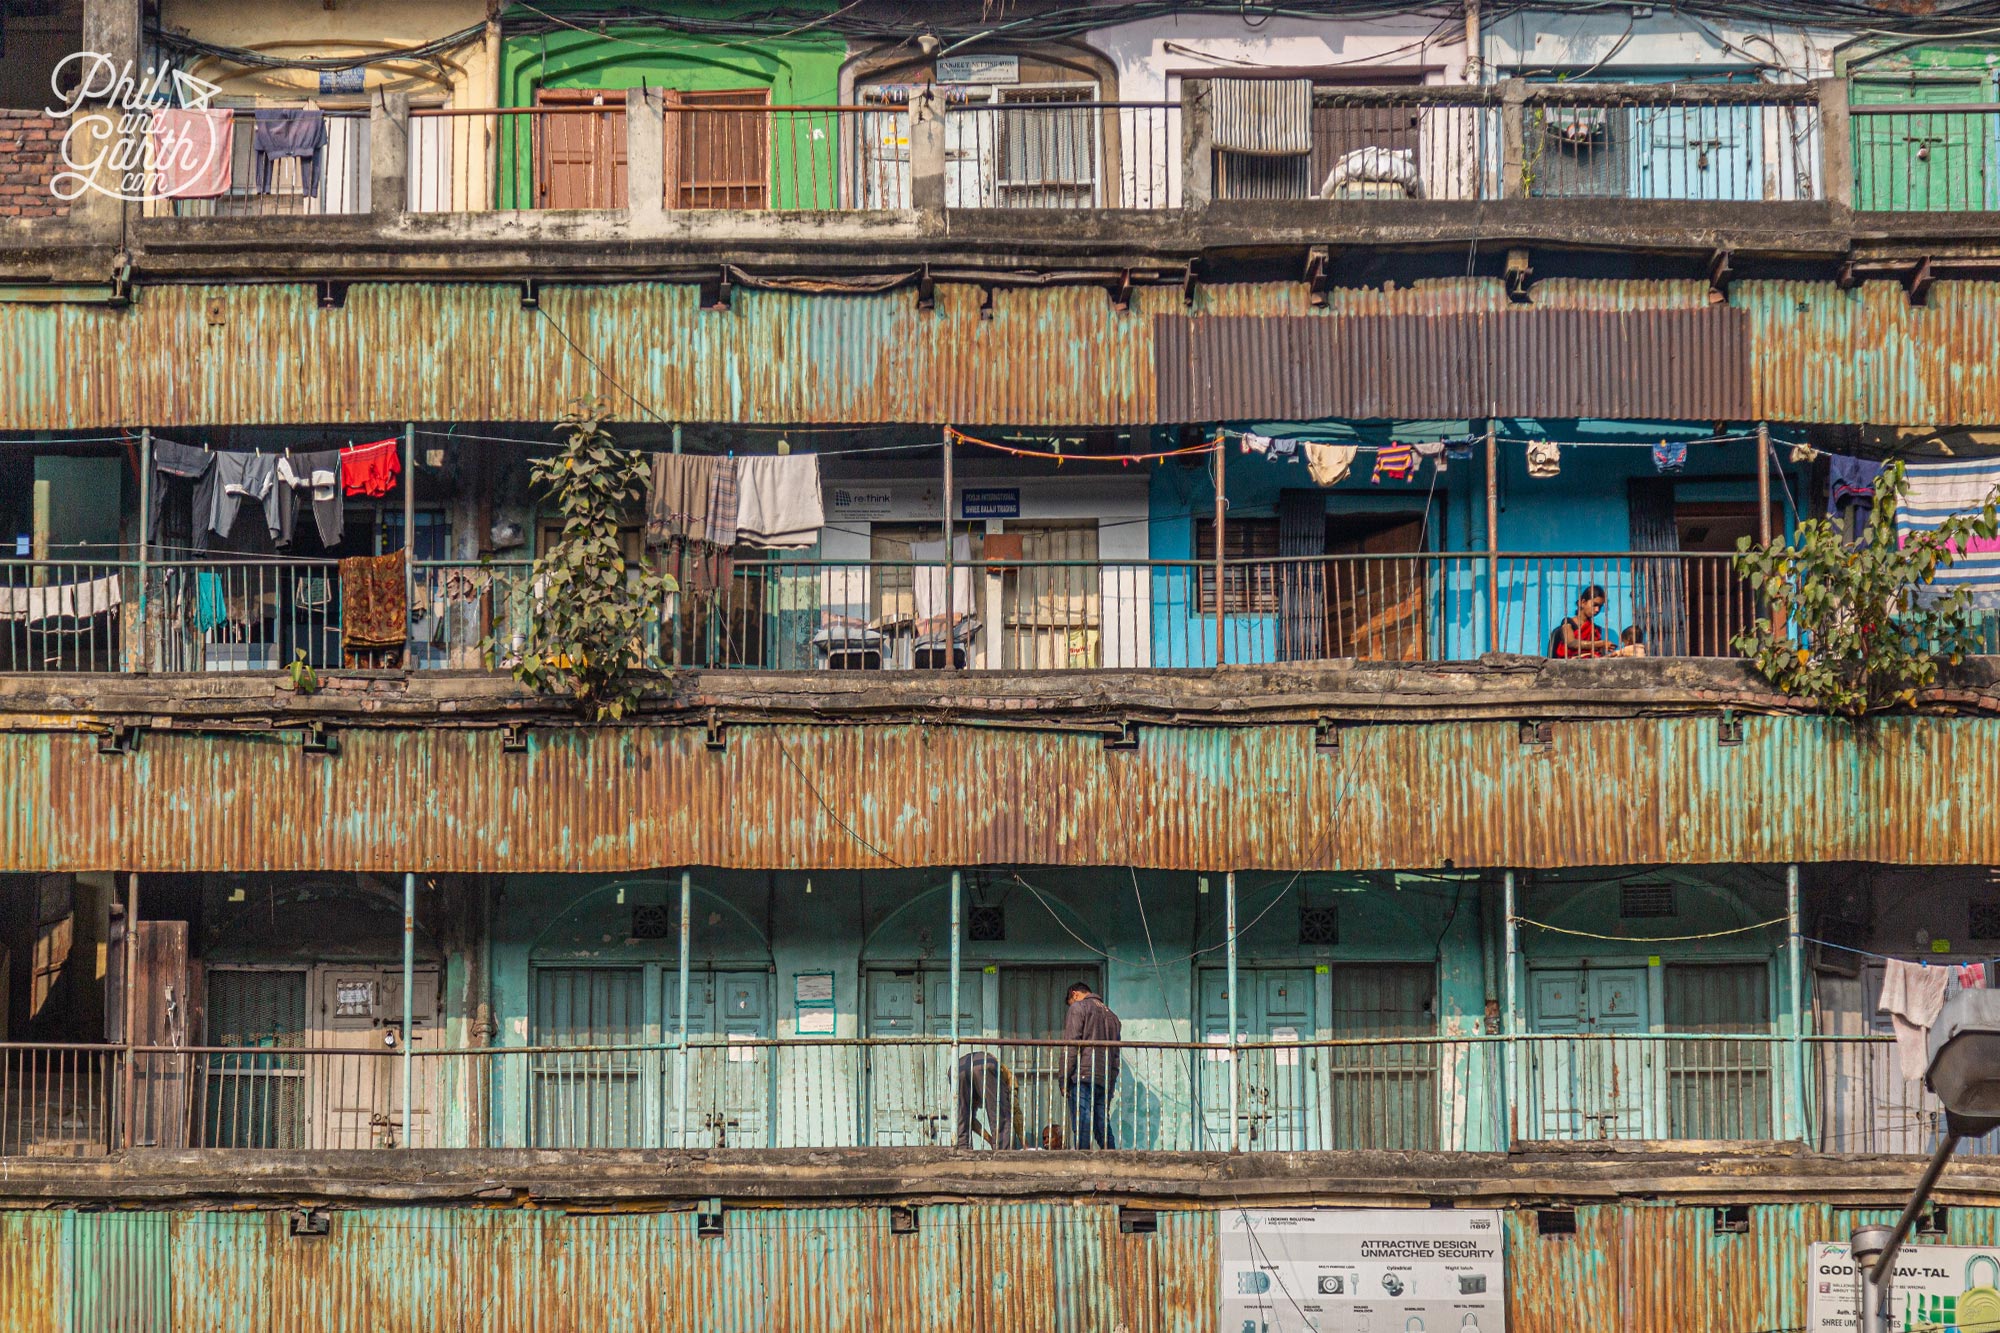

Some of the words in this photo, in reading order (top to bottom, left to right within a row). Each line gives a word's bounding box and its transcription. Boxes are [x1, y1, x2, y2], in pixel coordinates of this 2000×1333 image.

[1361, 1240, 1430, 1249] ATTRACTIVE
[1433, 1240, 1477, 1249] DESIGN
[1361, 1249, 1435, 1258] UNMATCHED
[1438, 1249, 1494, 1258] SECURITY
[1821, 1318, 1843, 1327] SHREE
